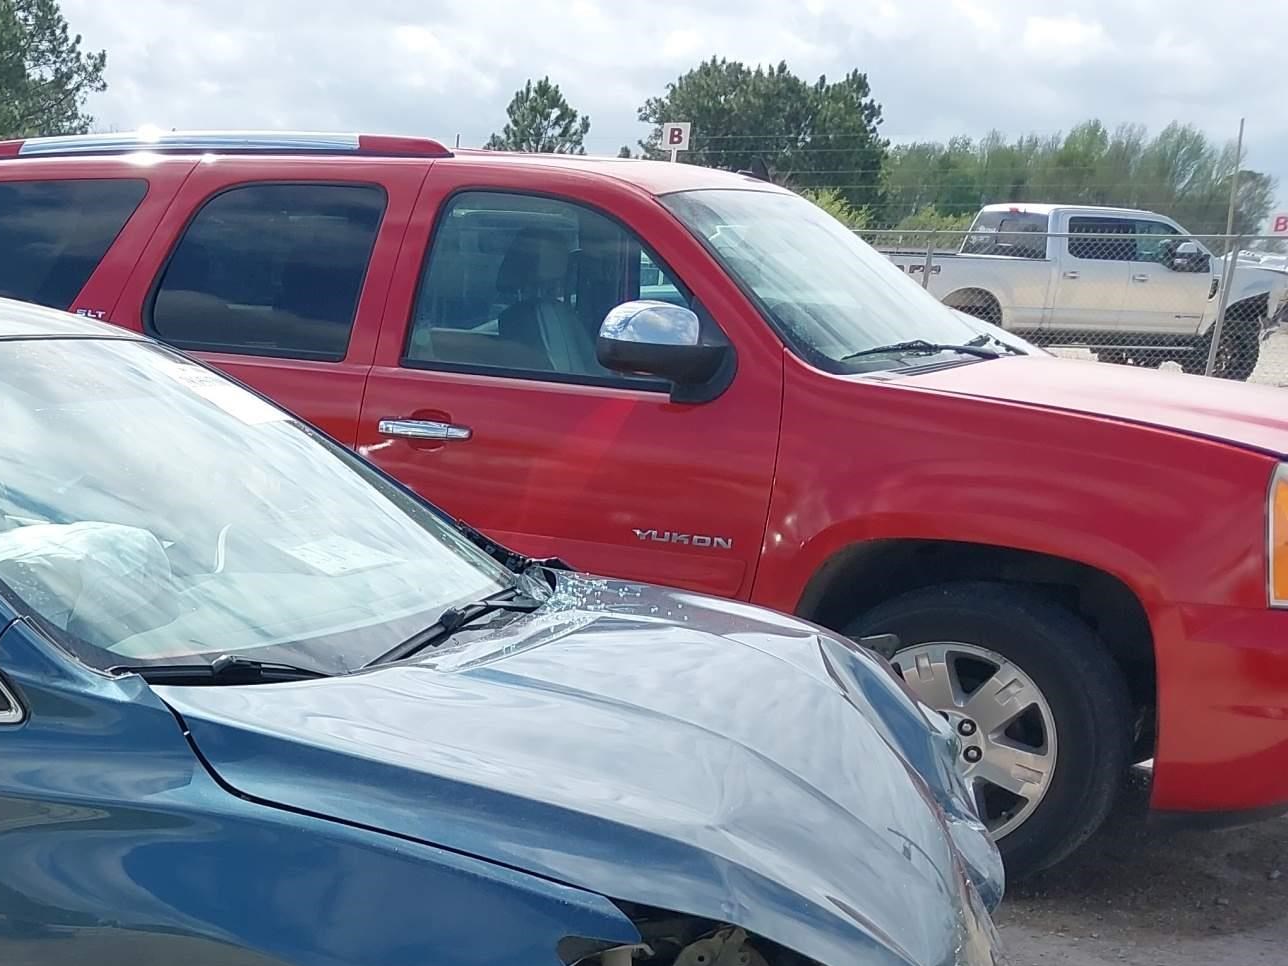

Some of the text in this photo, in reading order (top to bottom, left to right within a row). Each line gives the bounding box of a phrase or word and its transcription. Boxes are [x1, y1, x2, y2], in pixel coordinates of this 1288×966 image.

[669, 128, 683, 145] B
[1273, 216, 1288, 232] B
[76, 309, 106, 318] SLT
[632, 528, 733, 549] YUKON
